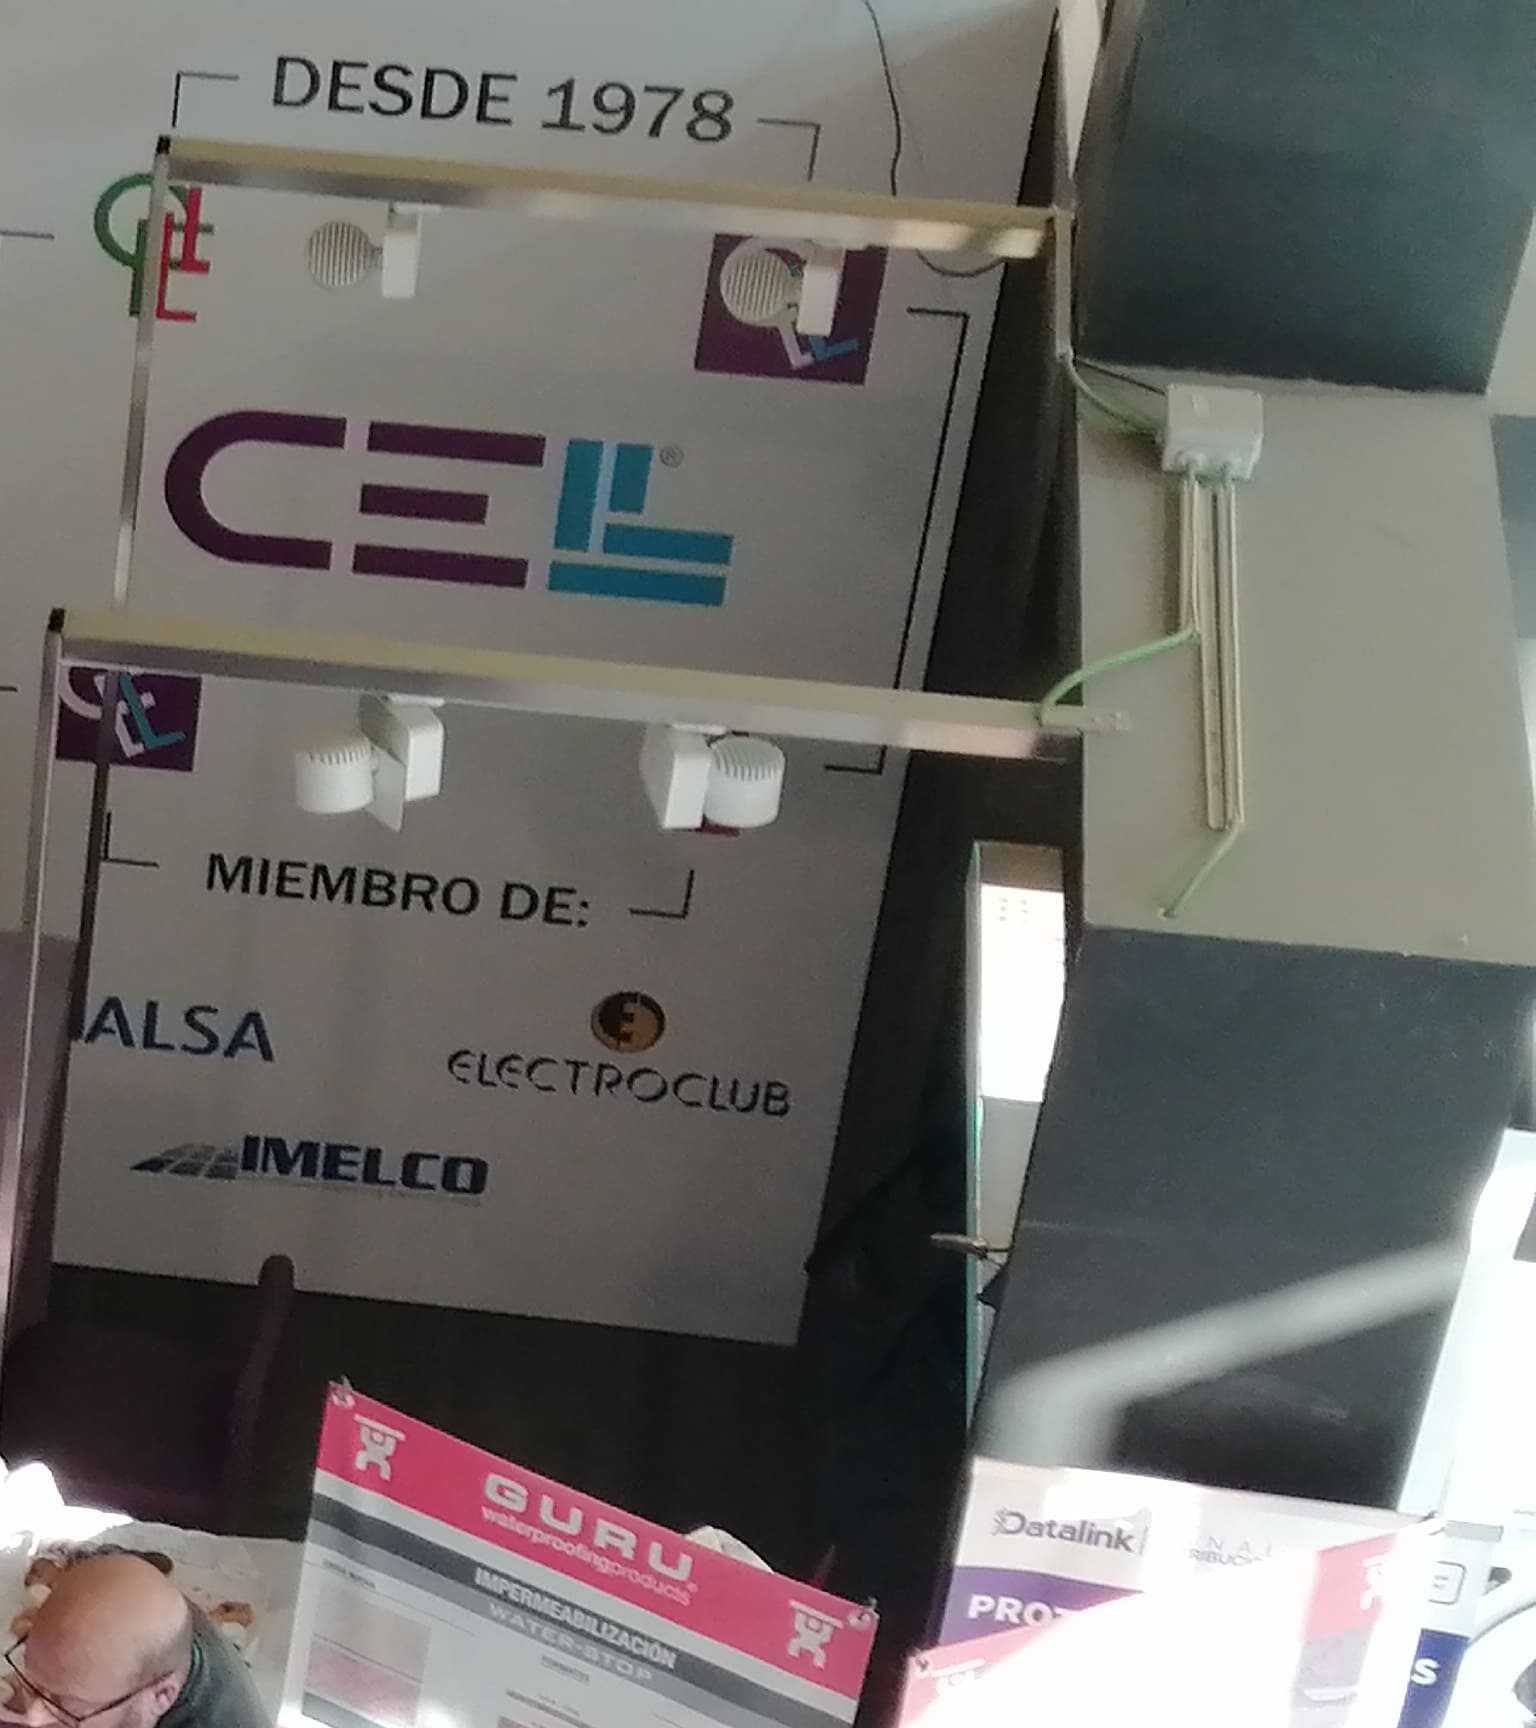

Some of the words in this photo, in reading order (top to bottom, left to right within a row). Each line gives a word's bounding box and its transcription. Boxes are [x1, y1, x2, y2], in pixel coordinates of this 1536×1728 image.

[271, 55, 519, 127] DESDE
[541, 76, 735, 144] 1978
[205, 852, 481, 918] MIEMBRO
[499, 885, 590, 927] DE:
[72, 994, 276, 1064] ALSA
[447, 1047, 793, 1119] ELECTROCLUB
[240, 1135, 490, 1199] IMELCO
[484, 1472, 693, 1581] GURU
[993, 1506, 1135, 1554] Datalink
[474, 1566, 678, 1669] IMPERMEABILIZACIÓN
[488, 1601, 674, 1682] WATER-STOP
